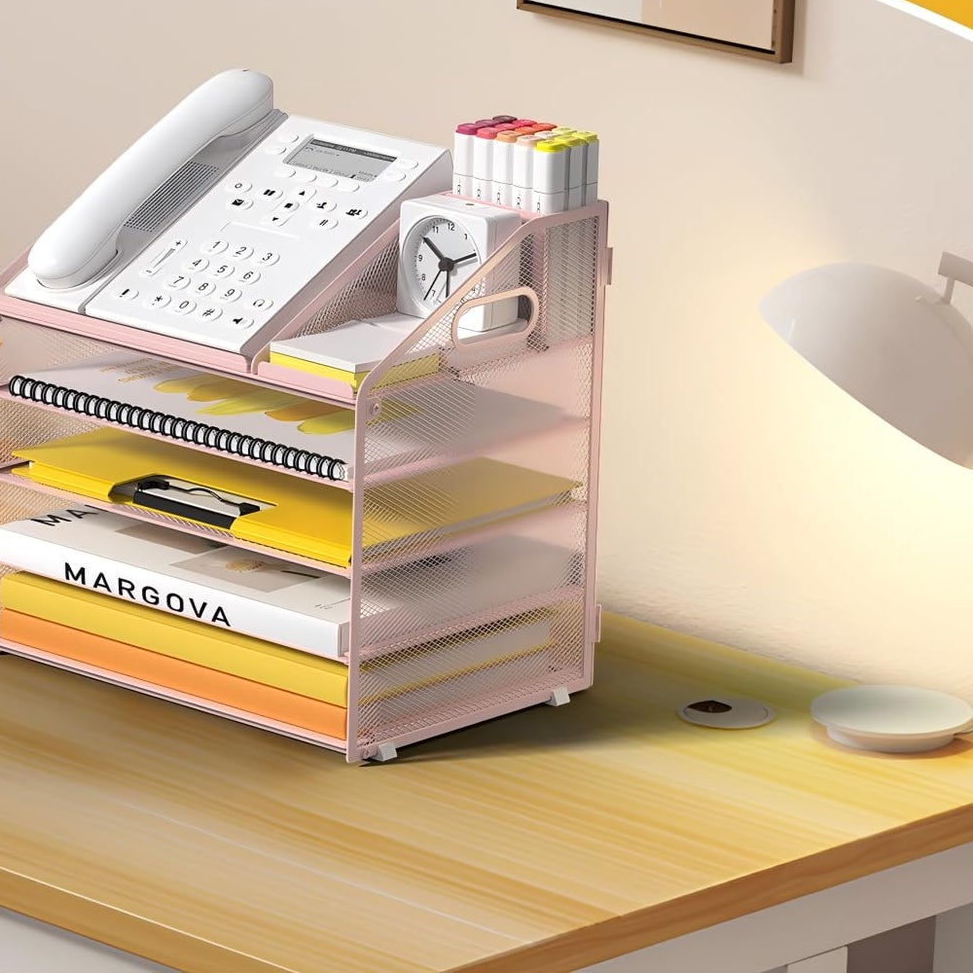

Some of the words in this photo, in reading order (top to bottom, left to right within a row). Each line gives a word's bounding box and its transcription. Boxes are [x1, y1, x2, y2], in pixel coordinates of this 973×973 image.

[432, 225, 439, 233] 11
[447, 223, 455, 231] 12
[212, 240, 221, 249] 1
[235, 246, 247, 255] 2
[262, 252, 273, 262] 3
[192, 258, 202, 267] 4
[216, 264, 228, 274] 5
[243, 270, 254, 279] 6
[173, 276, 184, 284] 7
[198, 282, 209, 291] 8
[224, 288, 235, 297] 9
[179, 300, 189, 309] 0
[64, 562, 231, 627] MARGOVA
